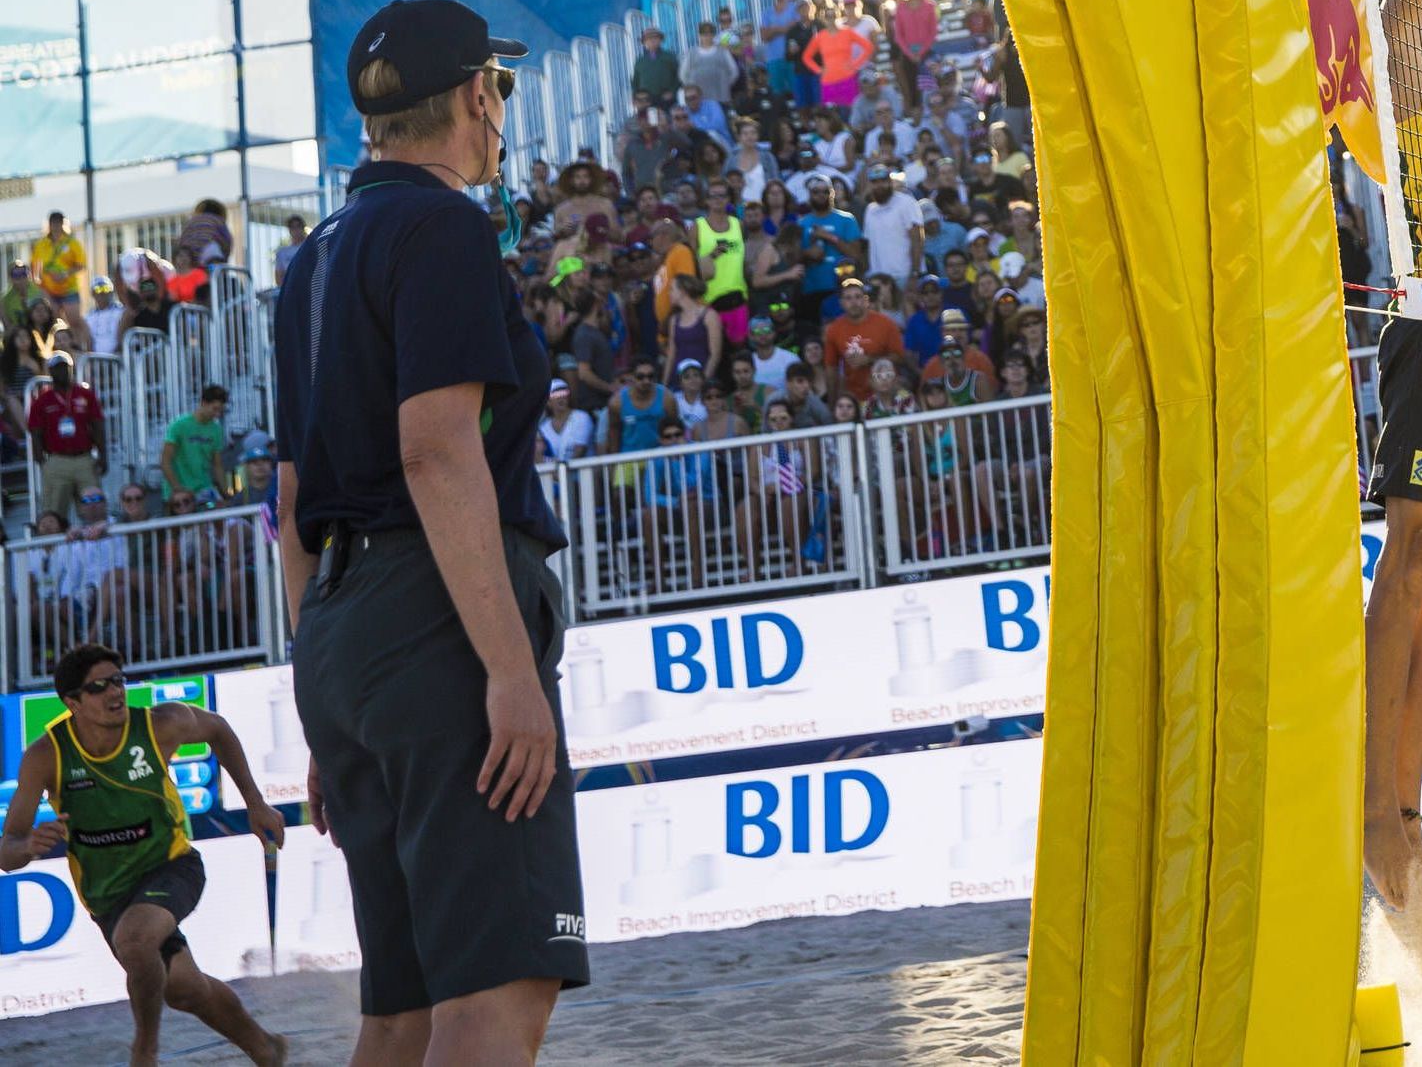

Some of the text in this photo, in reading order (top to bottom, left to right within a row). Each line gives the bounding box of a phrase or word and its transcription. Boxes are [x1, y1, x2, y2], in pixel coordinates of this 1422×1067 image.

[651, 611, 804, 694] BID
[891, 702, 952, 725] Beach
[626, 728, 747, 756] Improvement
[752, 718, 819, 742] District
[129, 745, 146, 769] 2
[128, 760, 154, 782] BRA
[264, 782, 306, 801] Beac
[725, 768, 890, 859] BID
[618, 914, 683, 934] Beach
[688, 897, 817, 927] Improvement
[824, 889, 898, 912] District
[949, 876, 1017, 899] Beach
[1, 987, 86, 1012] District
